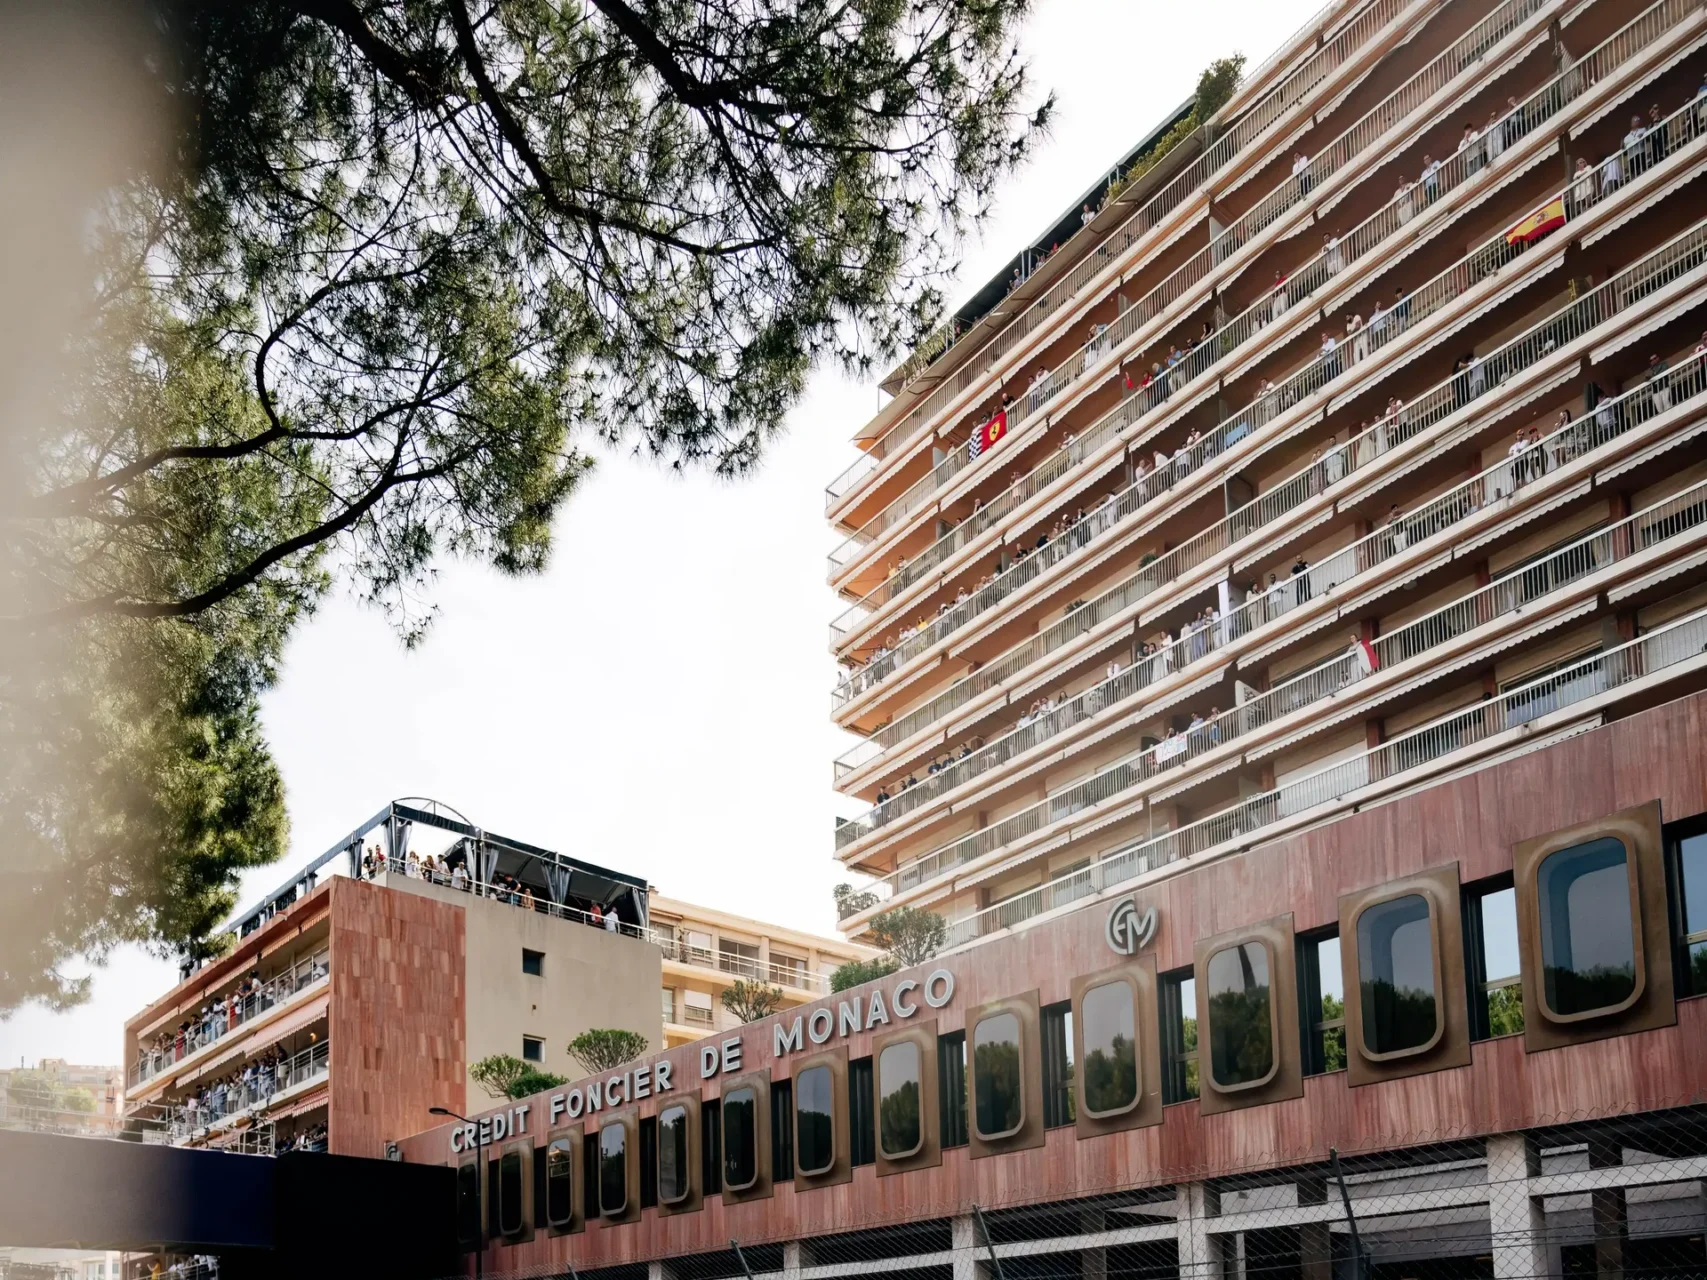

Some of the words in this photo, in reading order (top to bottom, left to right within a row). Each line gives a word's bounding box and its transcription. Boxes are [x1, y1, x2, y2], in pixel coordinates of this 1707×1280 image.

[450, 1105, 530, 1153] CREDIT
[551, 1060, 674, 1124] FONCIER
[701, 1036, 743, 1079] DE
[774, 968, 955, 1057] MONACO
